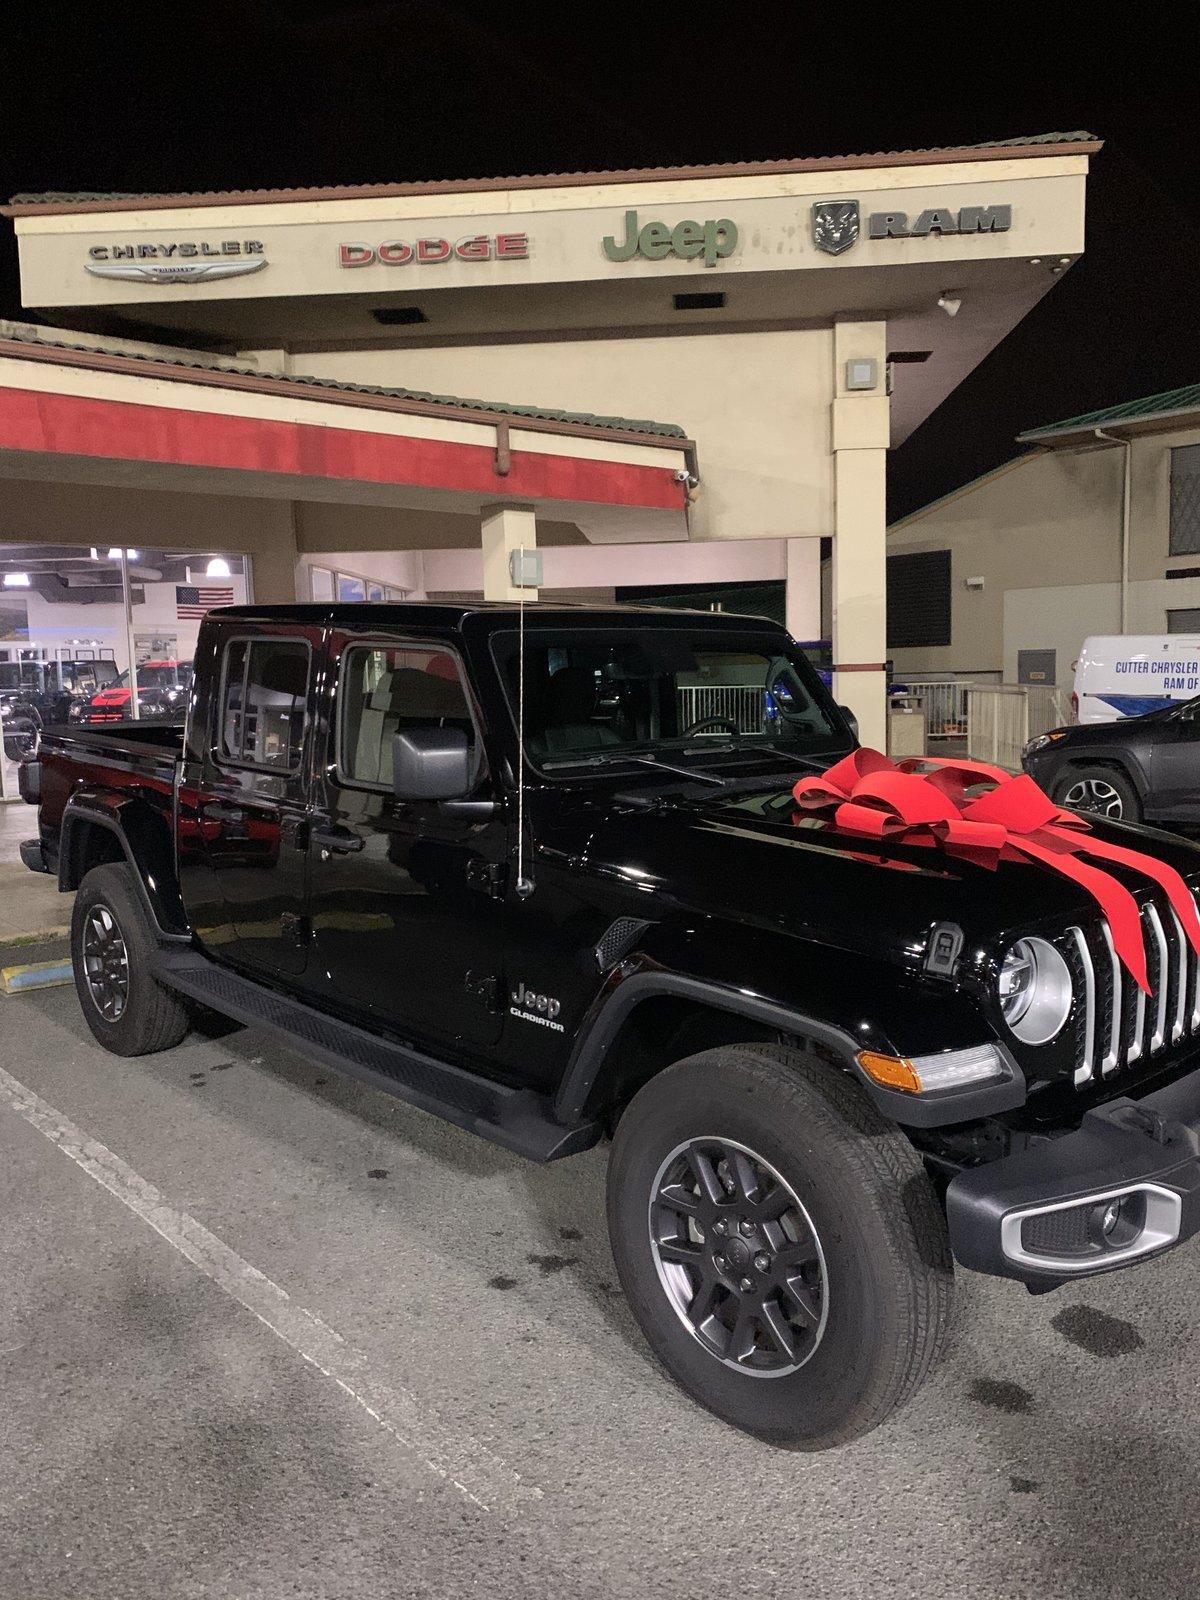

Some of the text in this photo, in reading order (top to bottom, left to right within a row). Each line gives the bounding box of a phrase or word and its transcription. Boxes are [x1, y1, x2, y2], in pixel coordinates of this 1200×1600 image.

[868, 204, 1012, 240] RAM
[88, 239, 265, 260] CHRYSLER
[338, 232, 530, 269] DODGE
[602, 209, 739, 268] Jeep
[1115, 662, 1198, 673] CUTTER CHRYSLER
[1163, 678, 1199, 689] RAM OF
[511, 982, 561, 1020] Jeep
[509, 1007, 564, 1033] GLADIATOR
